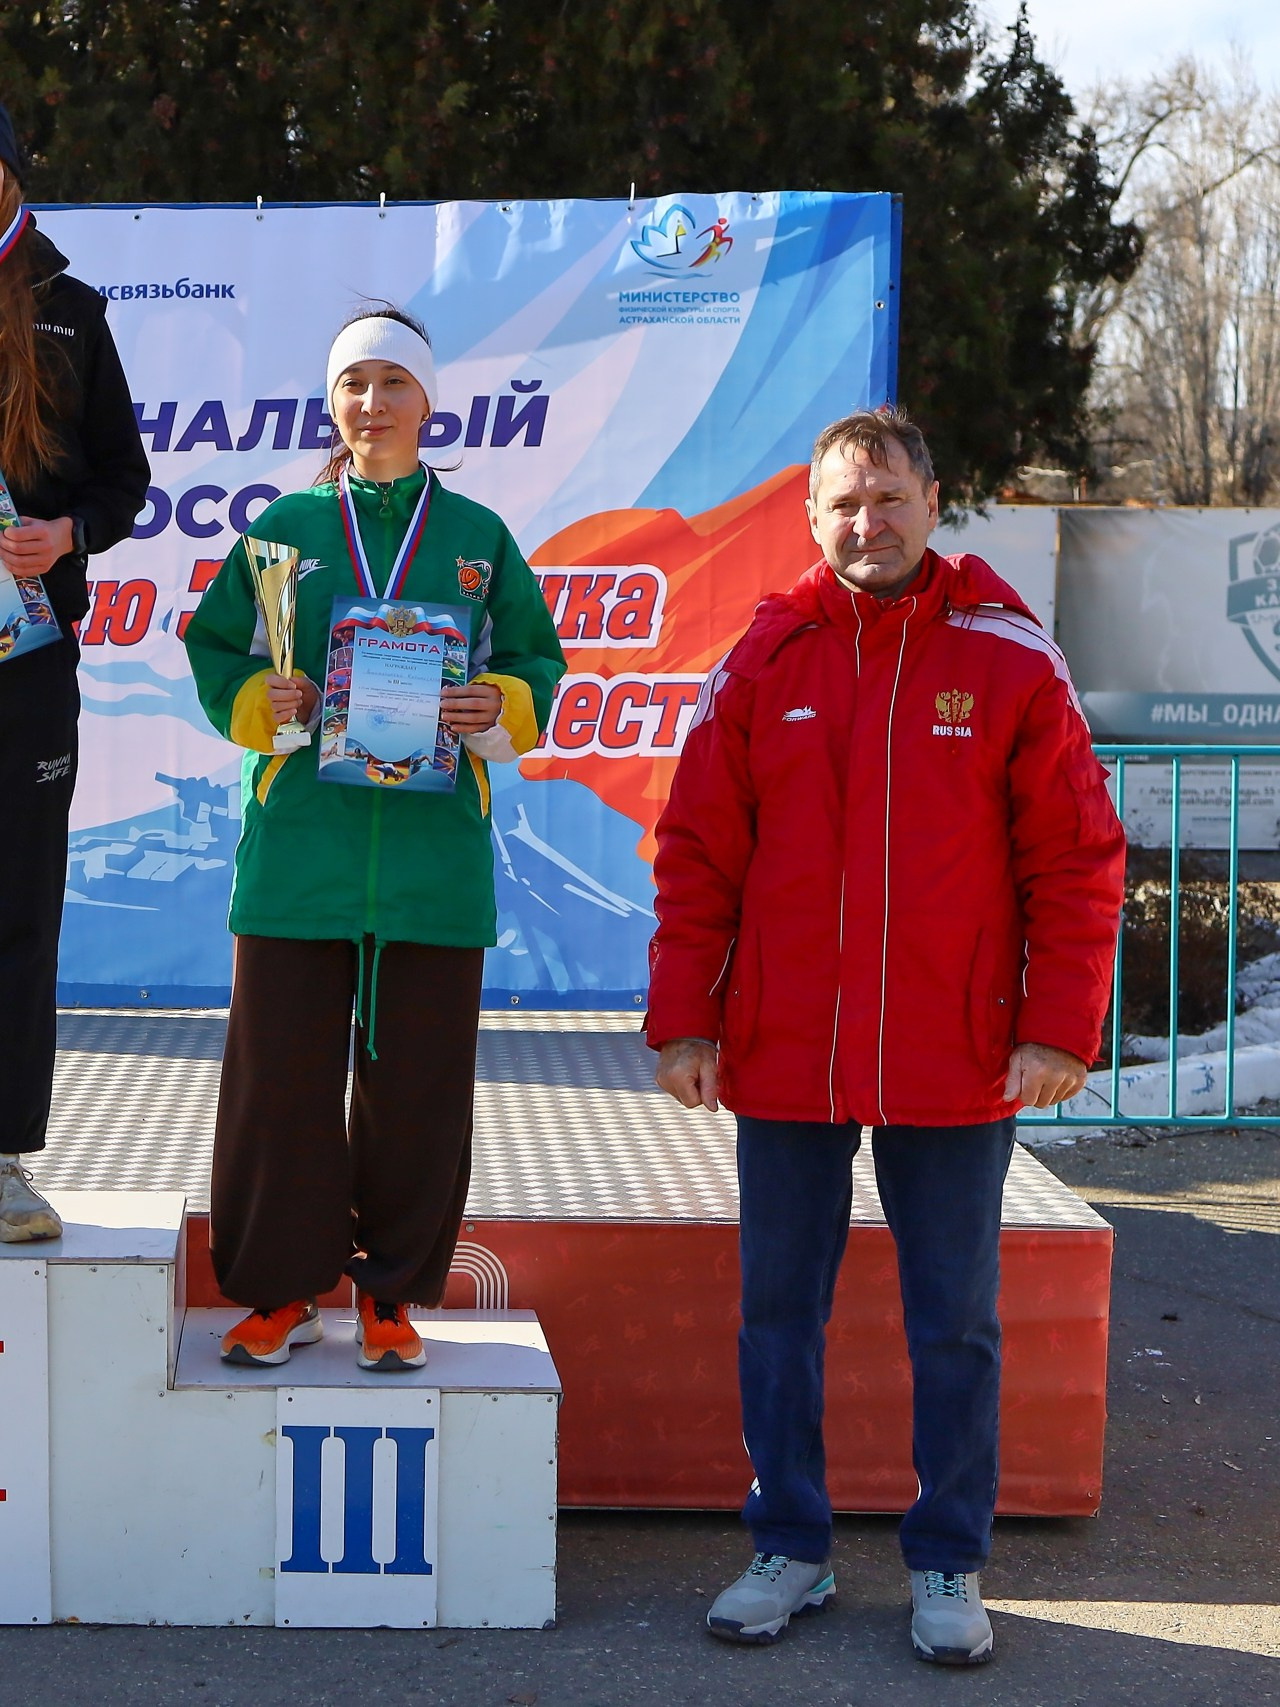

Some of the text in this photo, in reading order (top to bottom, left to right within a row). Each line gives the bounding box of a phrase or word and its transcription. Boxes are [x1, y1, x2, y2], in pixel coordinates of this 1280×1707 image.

[619, 291, 740, 303] МИНИСТЕРСТВО
[619, 315, 740, 324] АСТРАХАНСКОЙ ОБЛАСТИ
[299, 558, 320, 572] NIKE
[358, 637, 441, 655] ГРАМОТА
[280, 1425, 435, 1575] III
